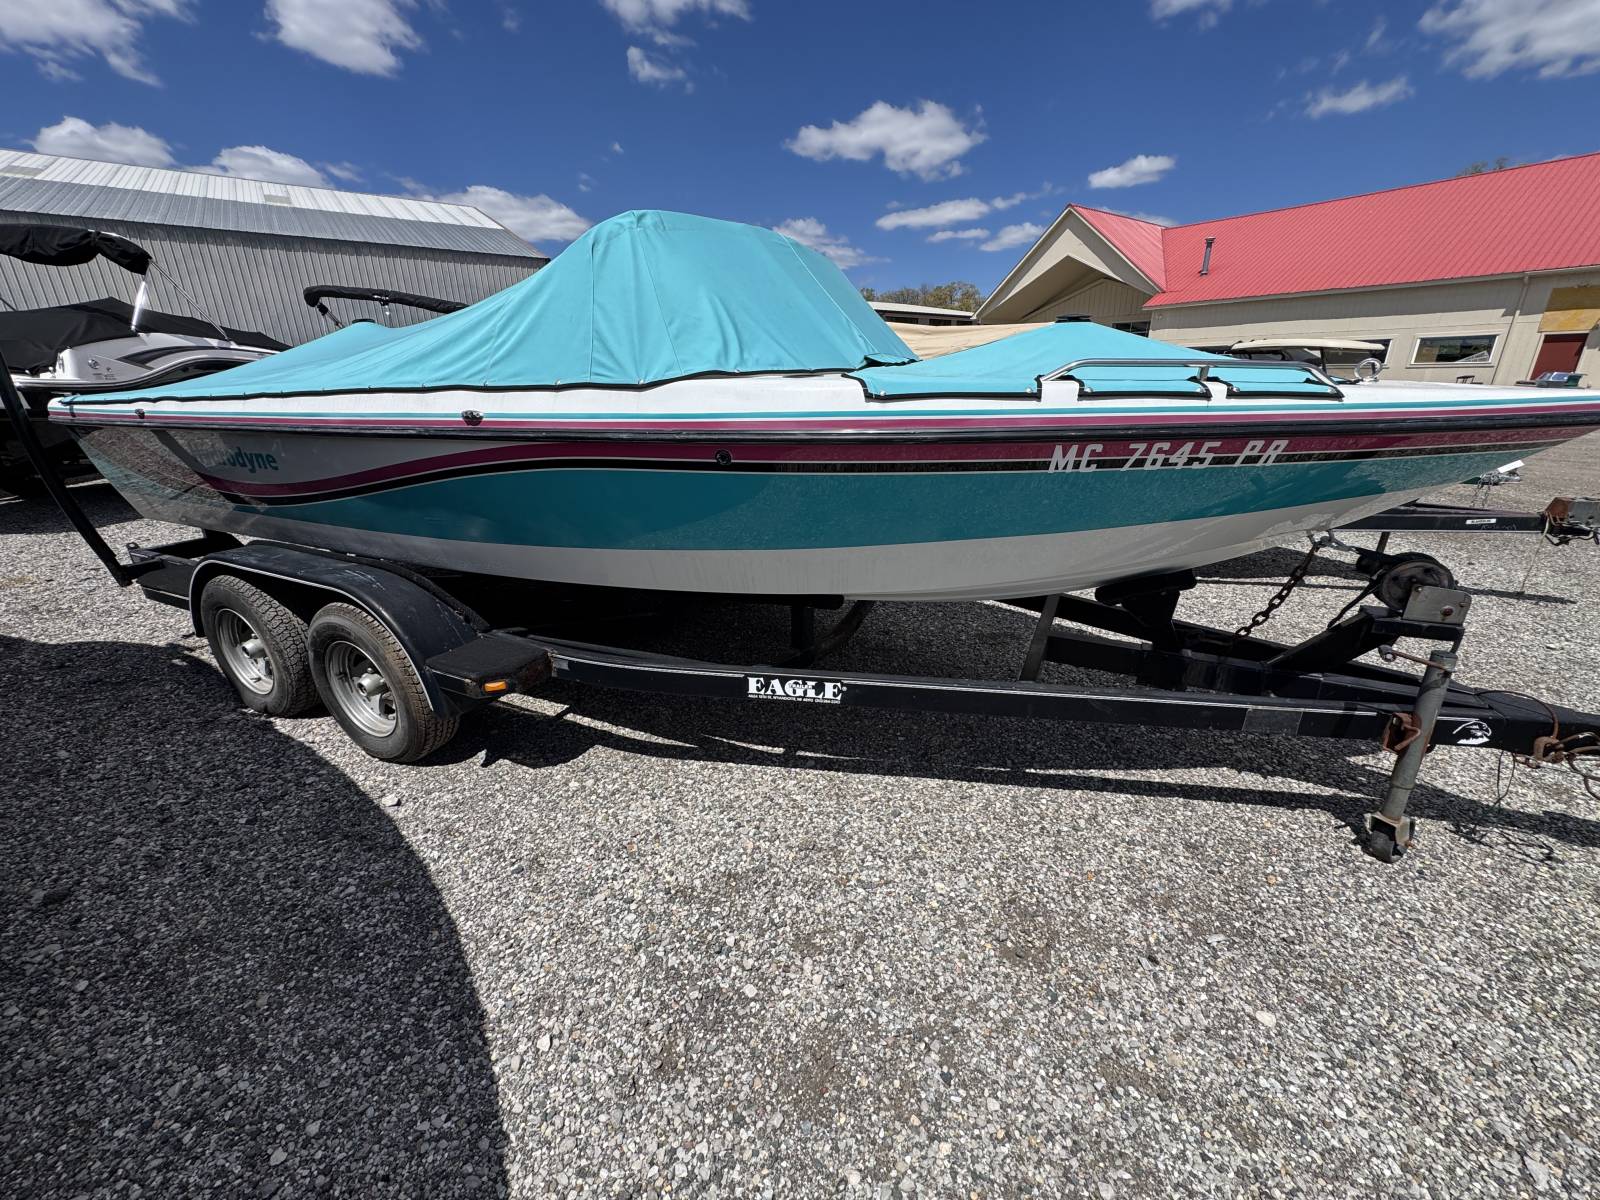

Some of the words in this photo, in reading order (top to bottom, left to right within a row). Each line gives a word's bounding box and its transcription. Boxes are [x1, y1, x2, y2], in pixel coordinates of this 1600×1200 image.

[1048, 444, 1103, 473] MC
[1120, 442, 1222, 471] 7645
[1233, 440, 1289, 467] PR
[747, 677, 842, 700] EAGLE
